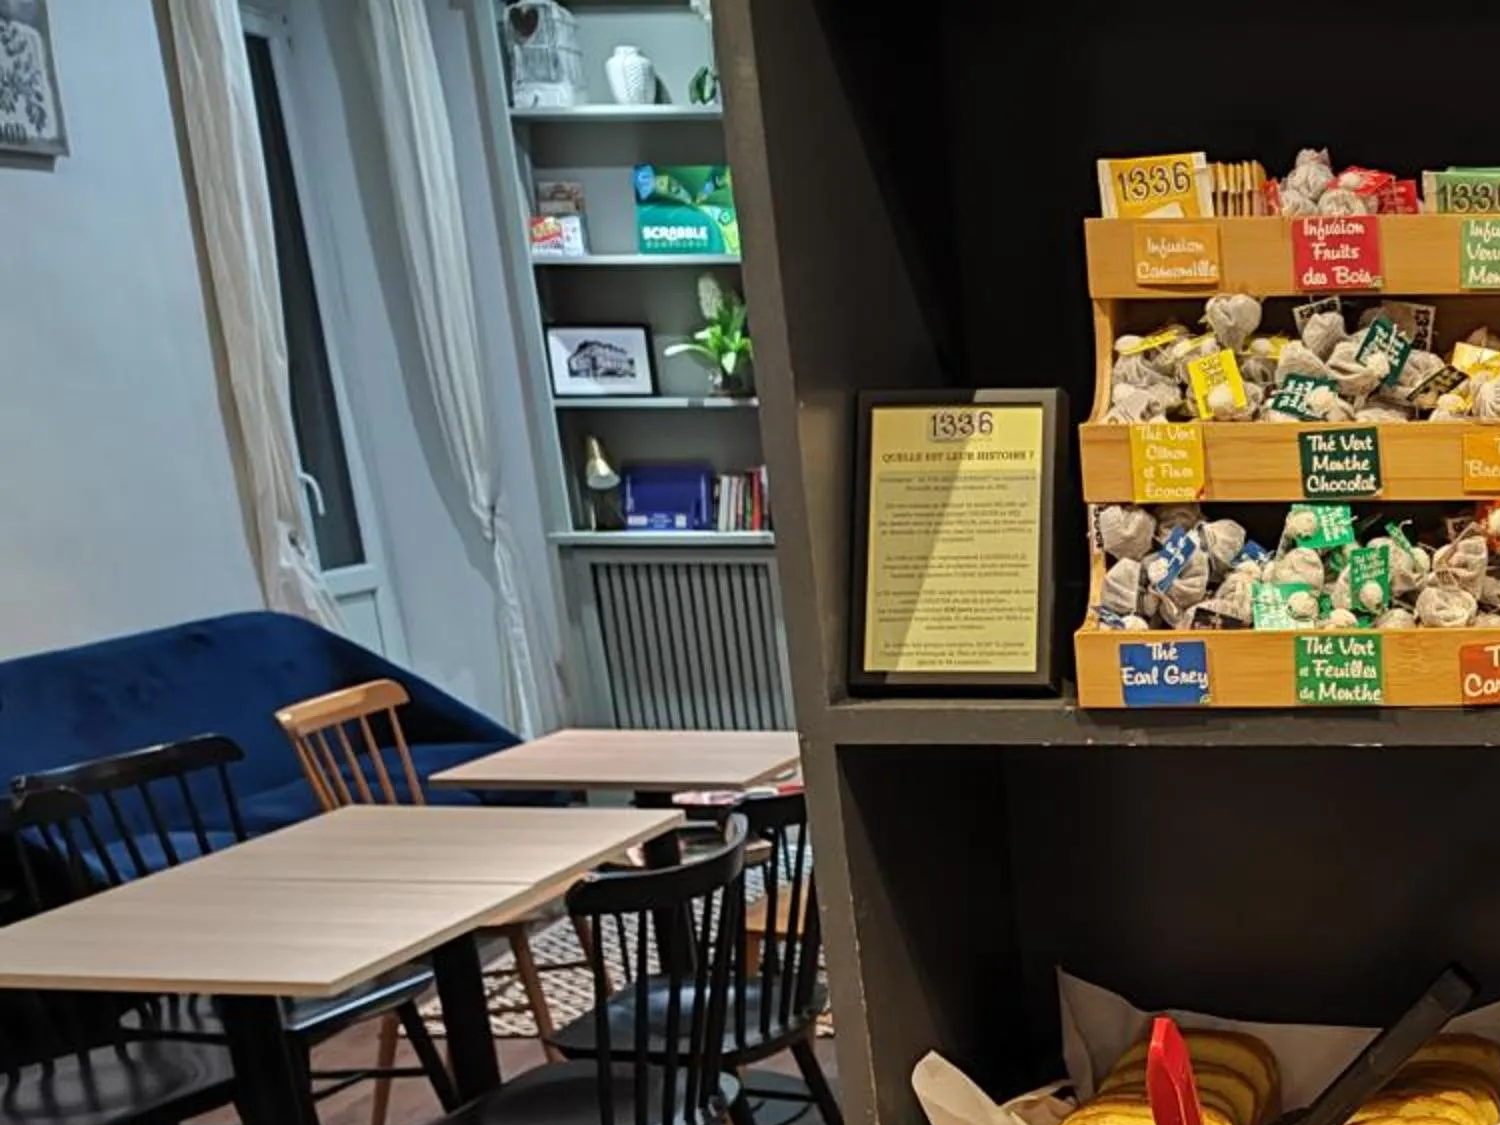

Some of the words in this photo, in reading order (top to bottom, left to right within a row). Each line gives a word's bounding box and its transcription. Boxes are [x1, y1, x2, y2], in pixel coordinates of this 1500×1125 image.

[1117, 161, 1191, 202] 1336
[643, 225, 708, 240] SCRABBLE
[1303, 217, 1365, 241] Infusion
[1312, 243, 1360, 261] Fruits
[1303, 267, 1328, 286] des
[1332, 265, 1371, 285] Bois
[931, 411, 994, 437] 1336
[1306, 434, 1336, 453] Thé
[1340, 432, 1375, 452] Vert
[1312, 453, 1371, 473] Menthe
[1306, 473, 1377, 493] Chocolat
[1145, 641, 1179, 661] Thé
[1301, 637, 1334, 654] Thé
[1338, 636, 1377, 656] Vert
[1121, 665, 1159, 687] Earl
[1163, 664, 1209, 690] Grey
[1318, 682, 1382, 701] Menthe
